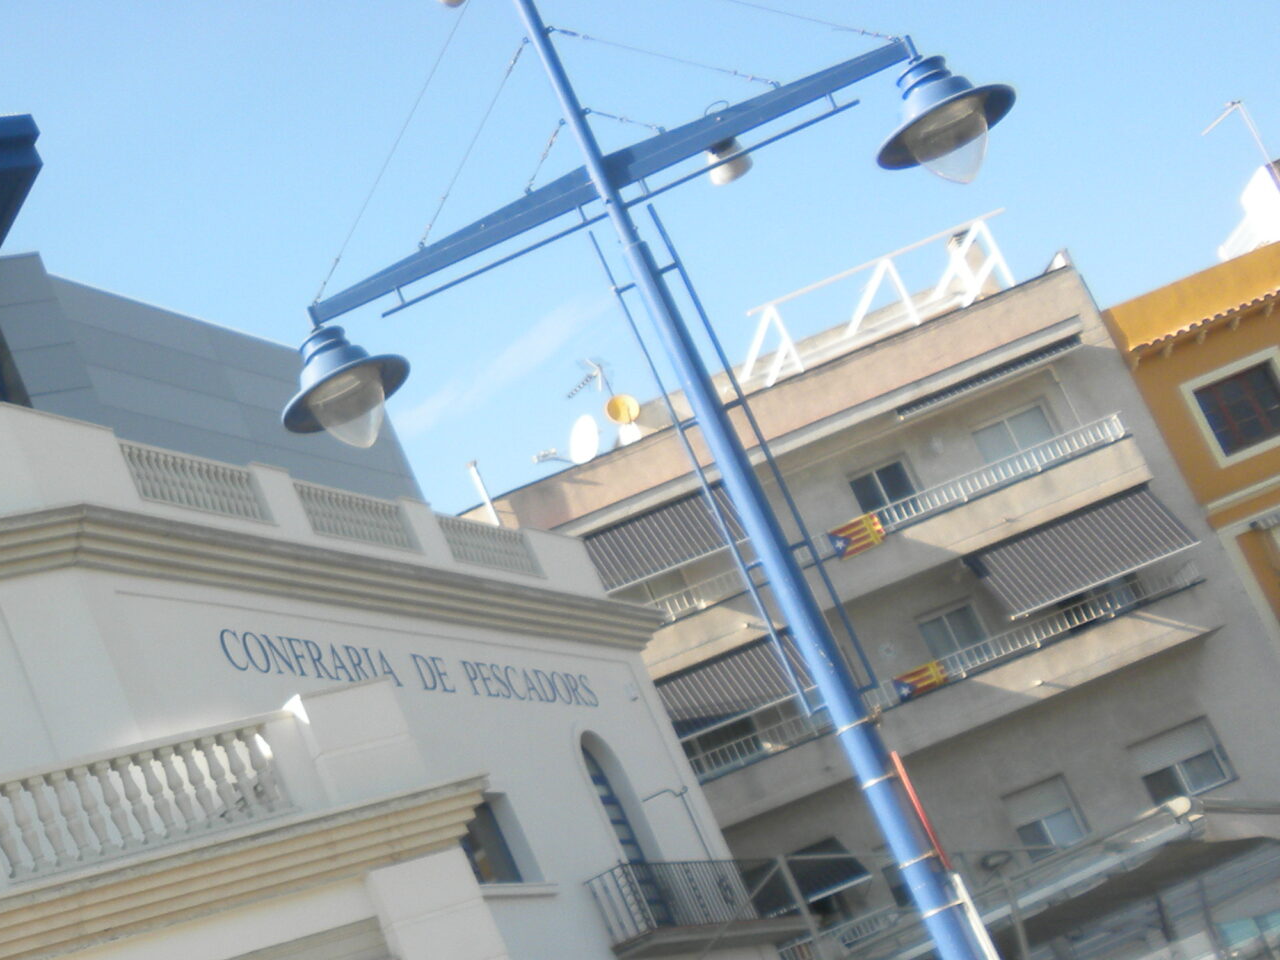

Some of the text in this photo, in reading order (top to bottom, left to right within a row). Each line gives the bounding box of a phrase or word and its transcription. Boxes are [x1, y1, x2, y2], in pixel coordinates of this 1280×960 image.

[219, 627, 600, 708] CONFRARIA DE PESCADORS
